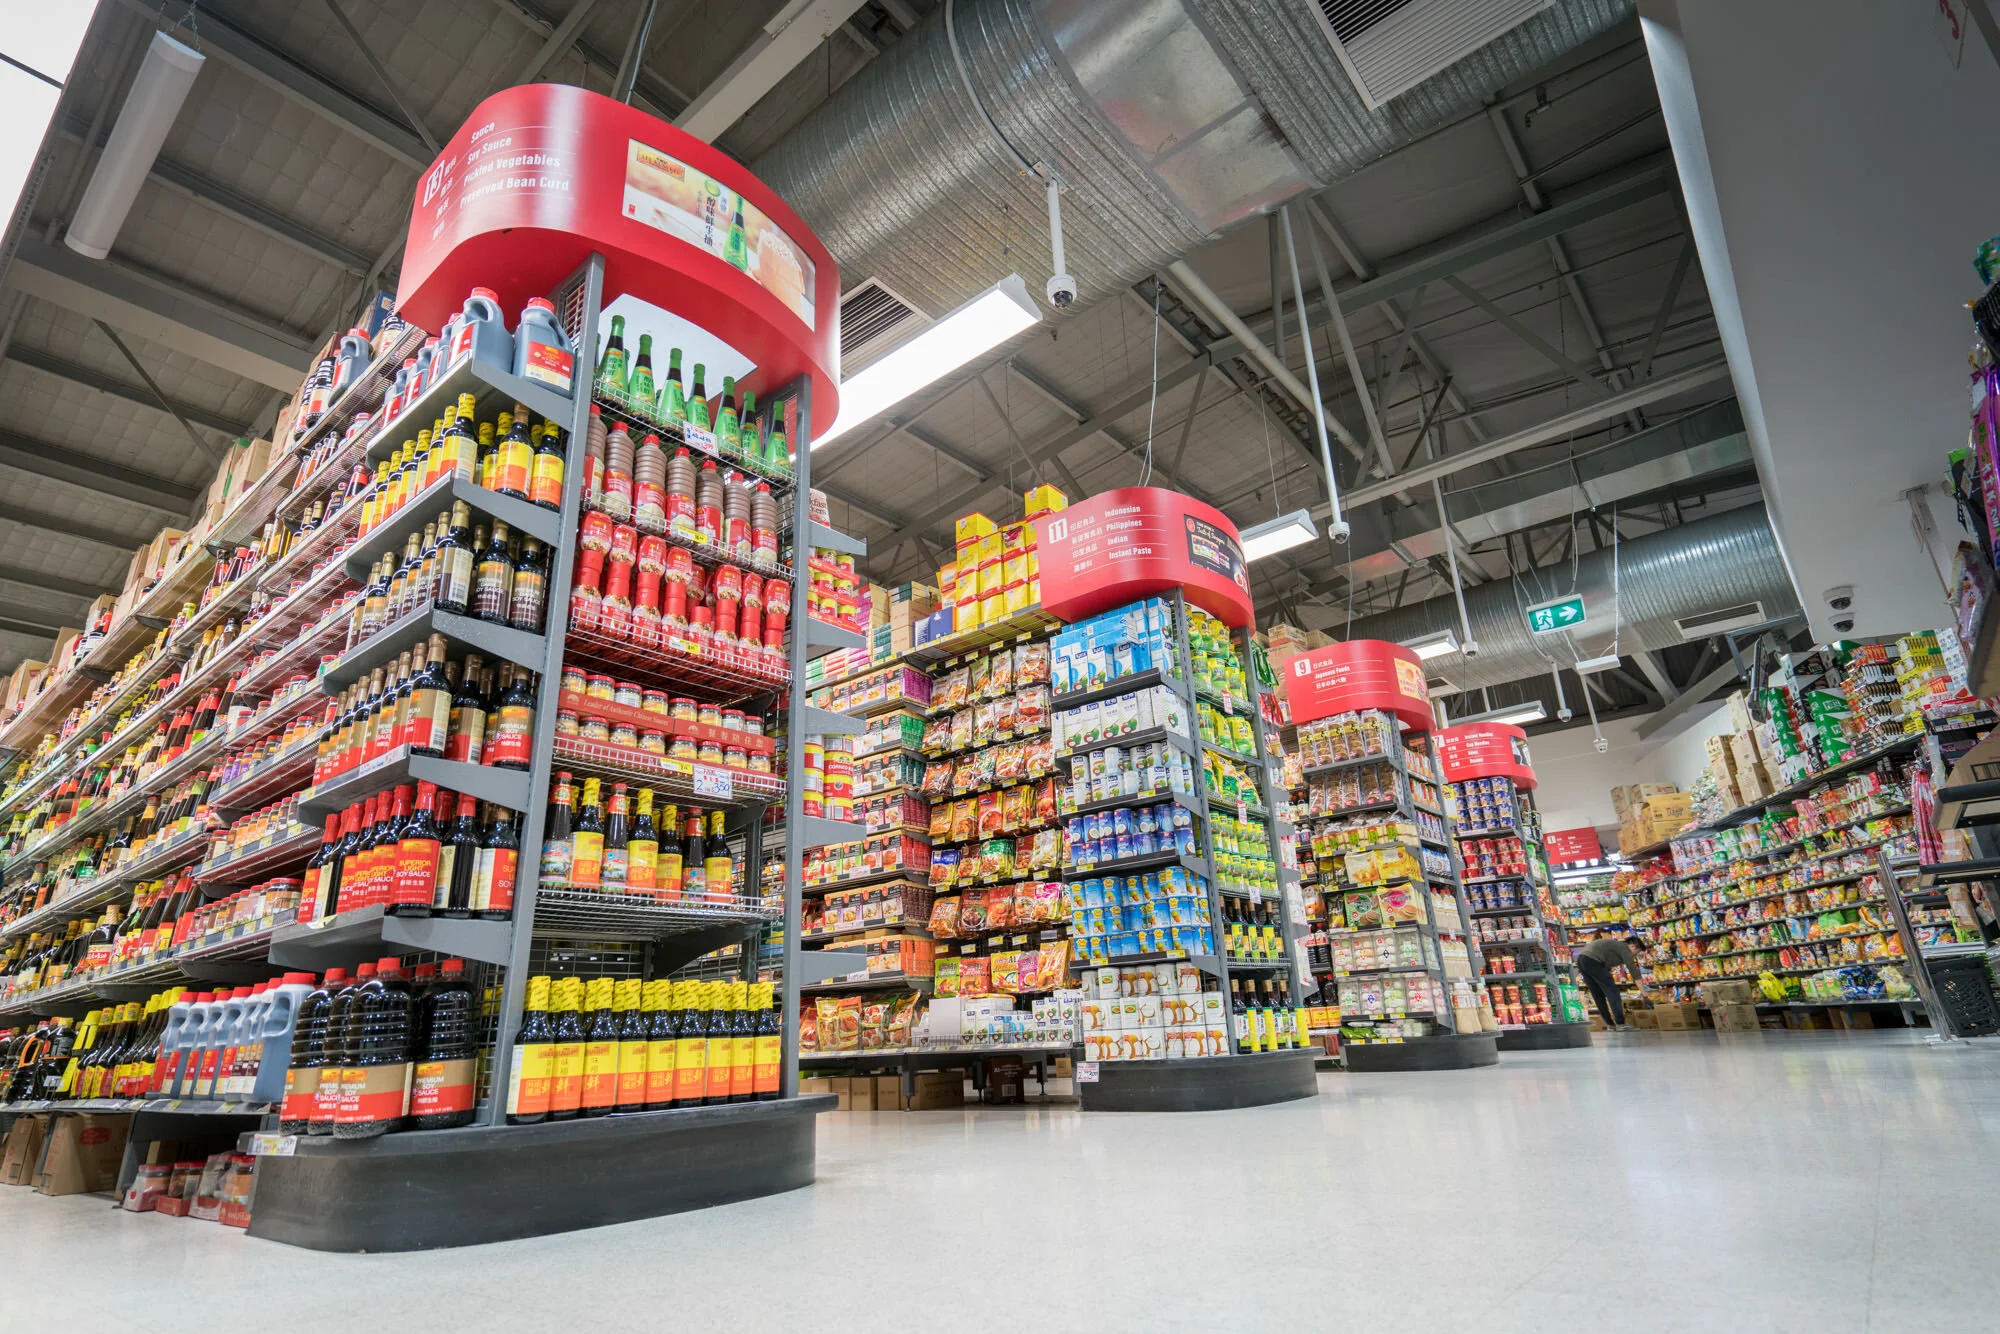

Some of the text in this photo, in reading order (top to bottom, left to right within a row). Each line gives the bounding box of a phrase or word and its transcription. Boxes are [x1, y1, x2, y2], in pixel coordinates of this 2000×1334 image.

[470, 122, 495, 143] Sauce
[467, 136, 512, 165] Soy Sauce
[463, 161, 494, 187] Pickled
[496, 154, 561, 169] Vegetables
[460, 179, 504, 209] Preserved
[506, 177, 536, 190] Bean
[539, 177, 570, 192] Curd
[1104, 506, 1141, 518] Indonesian
[1106, 519, 1143, 531] Philippines
[1107, 535, 1129, 545] Indian
[1109, 546, 1152, 560] Instant Paste
[1314, 670, 1336, 679] Japanese
[696, 779, 704, 790] 2
[409, 870, 431, 878] SAUCE
[418, 1088, 440, 1096] SAUCE
